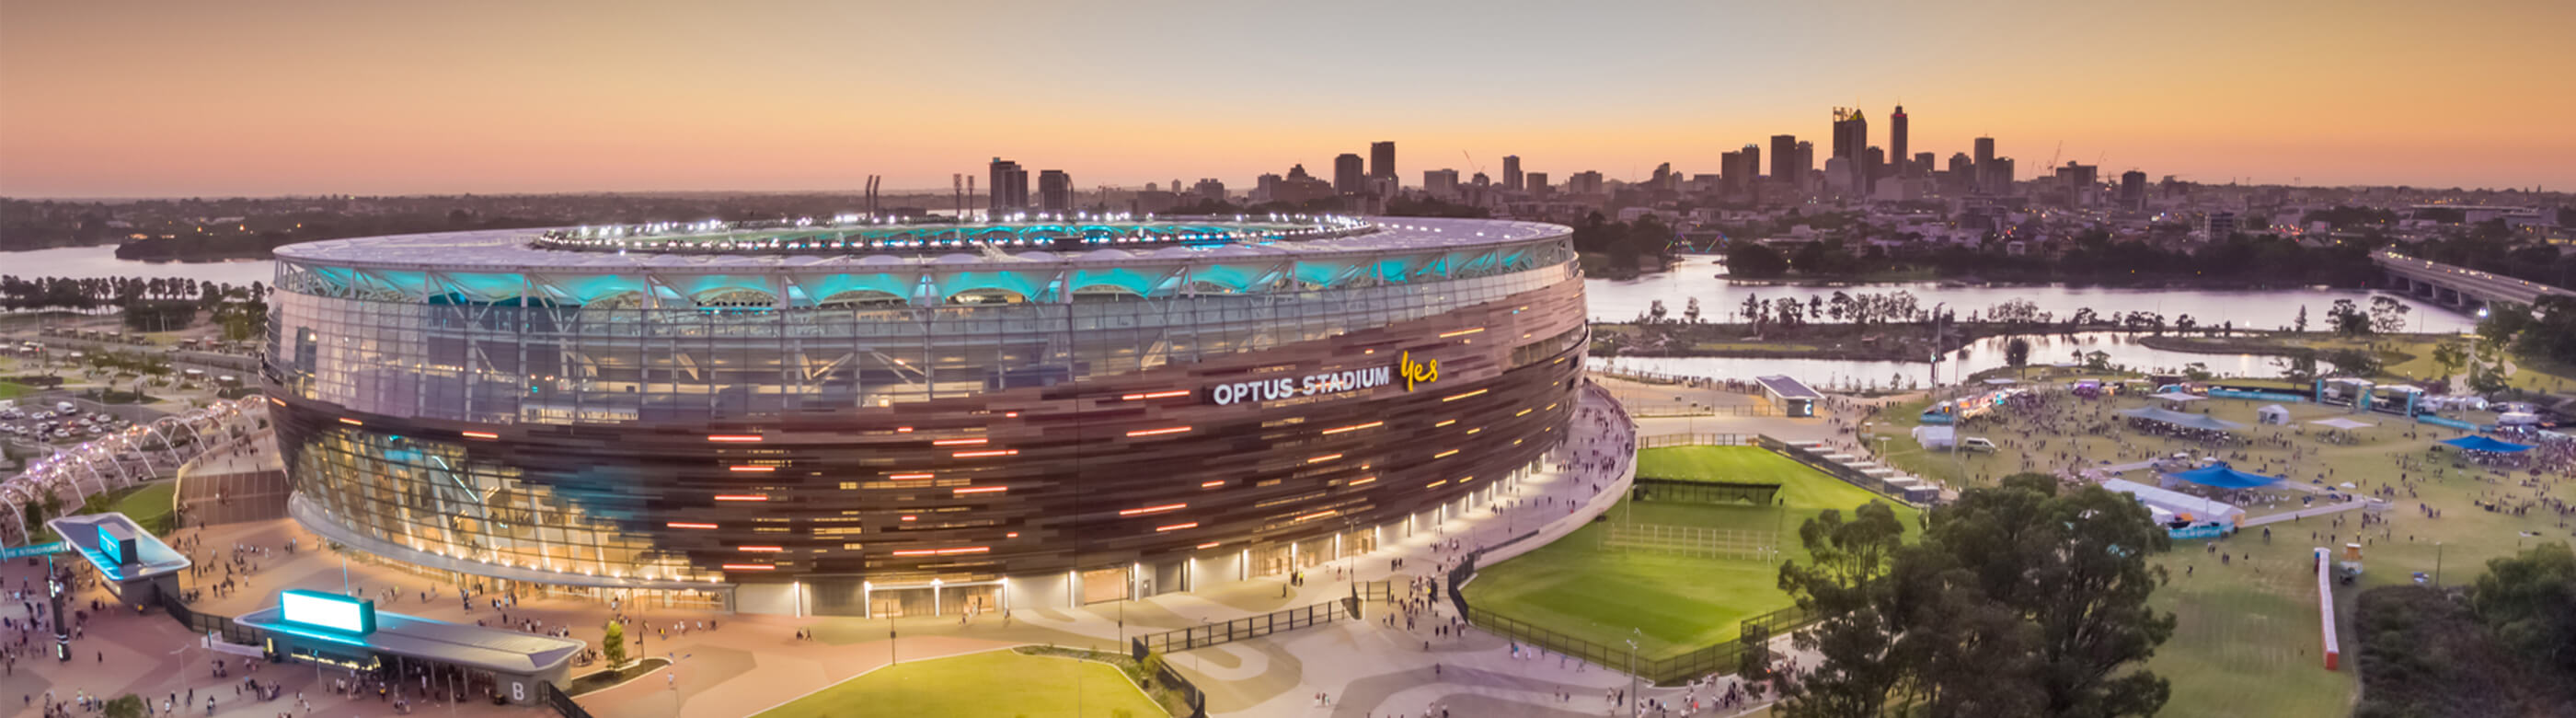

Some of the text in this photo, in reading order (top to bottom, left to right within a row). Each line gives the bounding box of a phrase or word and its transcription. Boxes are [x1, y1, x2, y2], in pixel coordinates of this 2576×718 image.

[1213, 366, 1389, 405] OPTUS STADIUM
[512, 682, 524, 700] B
